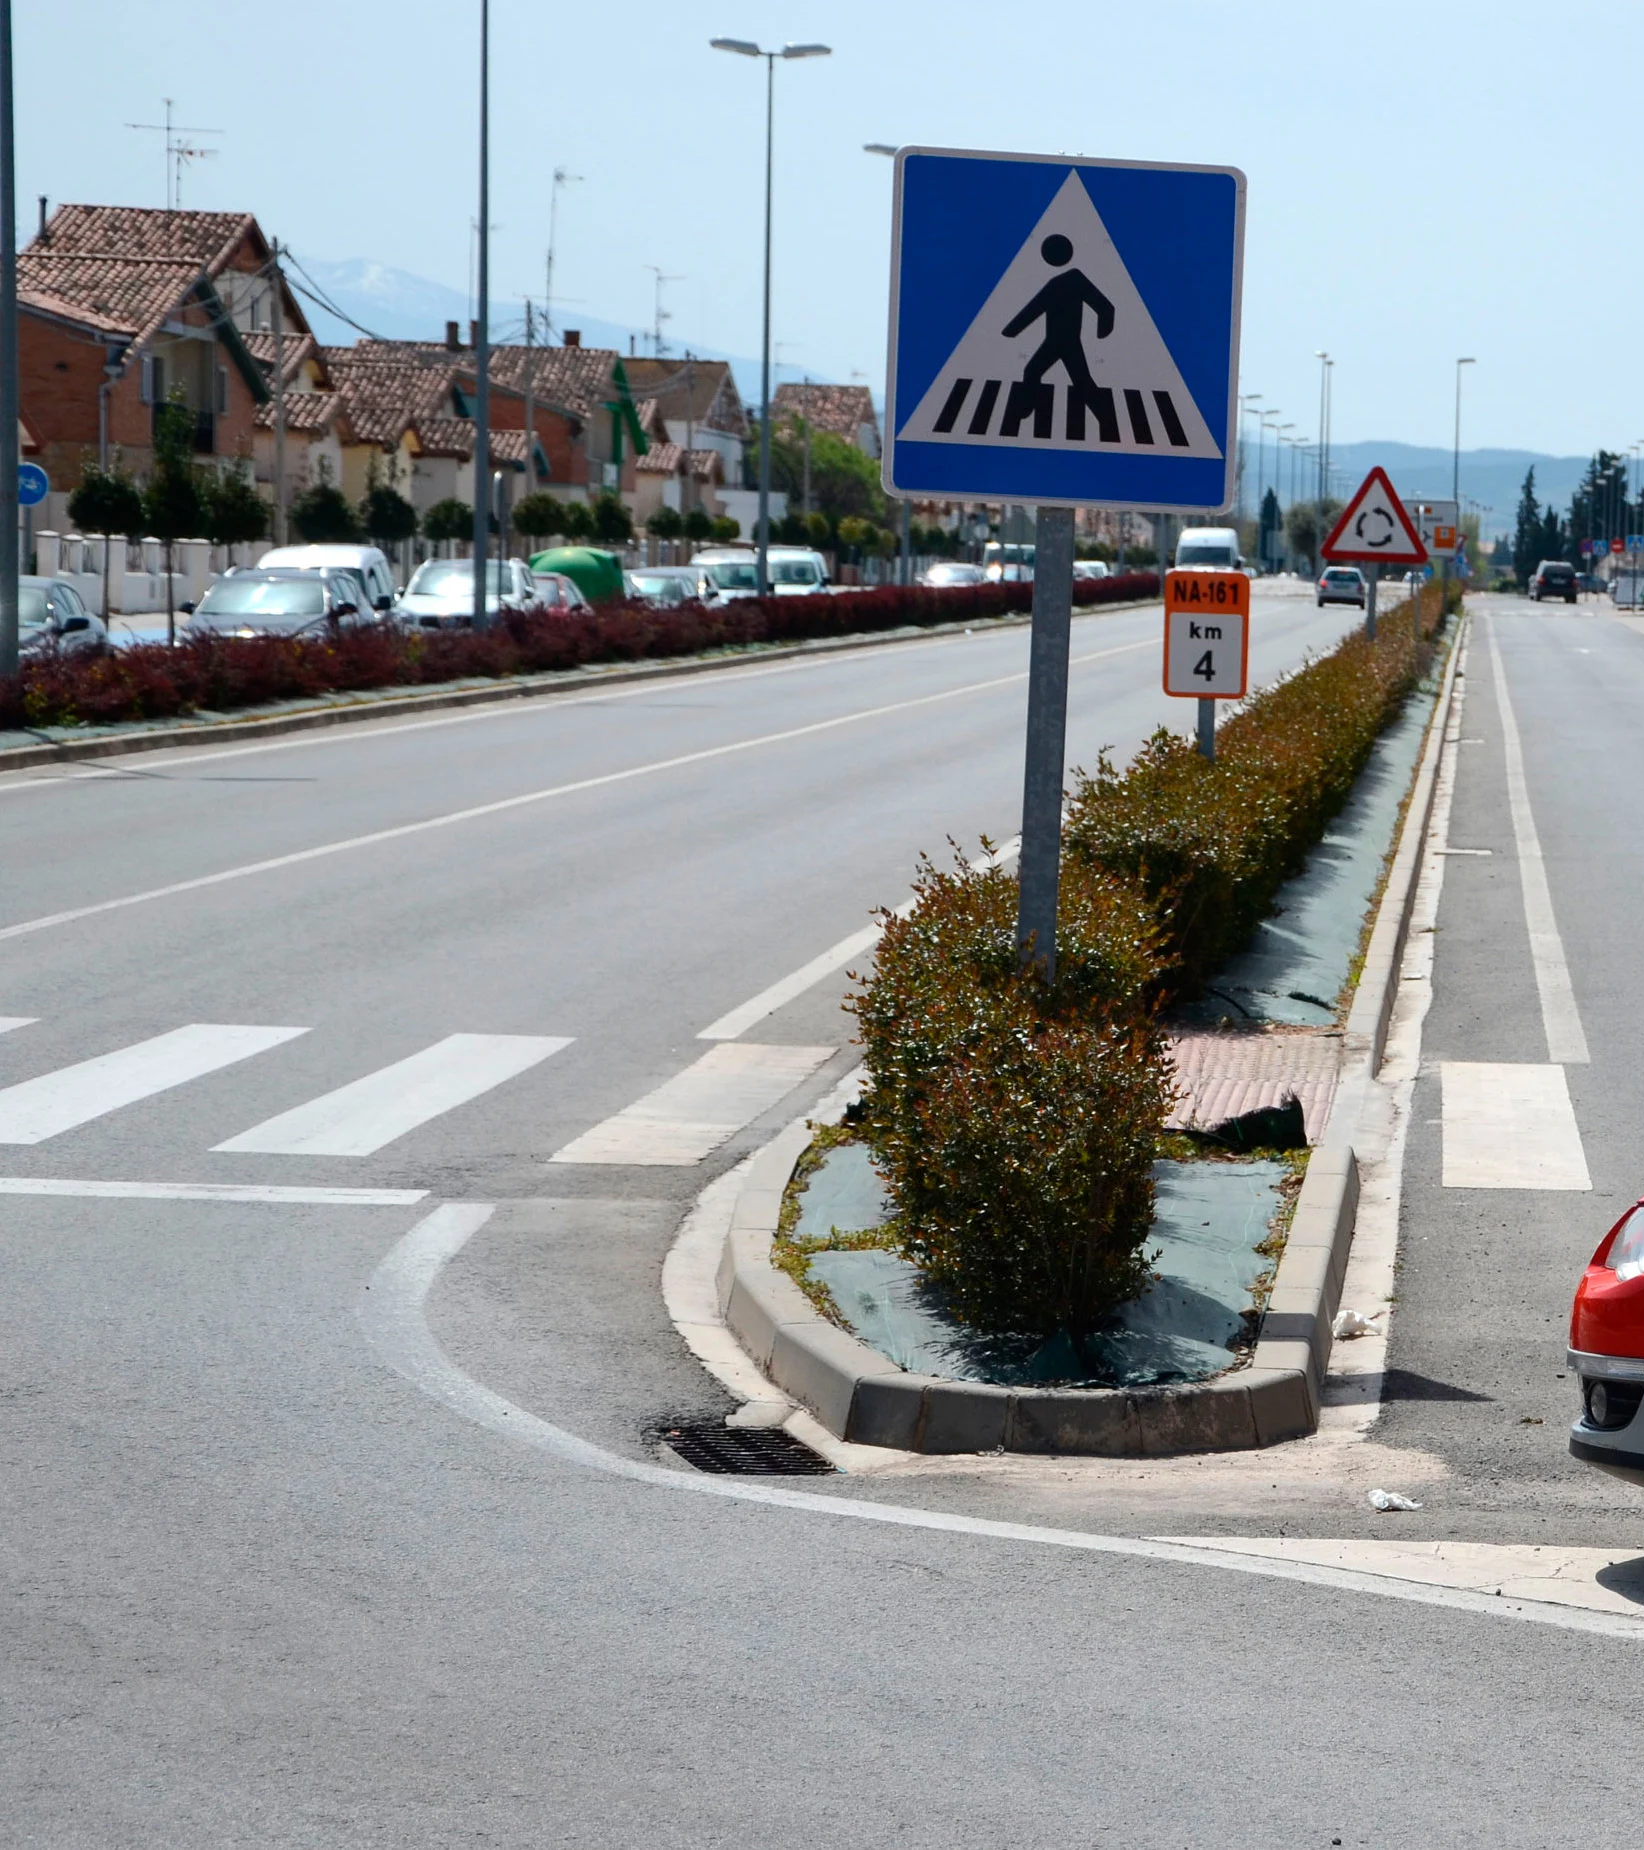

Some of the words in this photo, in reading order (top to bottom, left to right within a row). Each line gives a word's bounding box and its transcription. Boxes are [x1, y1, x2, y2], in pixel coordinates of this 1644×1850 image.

[1174, 579, 1239, 605] NA-161
[1189, 621, 1223, 640] km
[1193, 649, 1216, 682] 4
